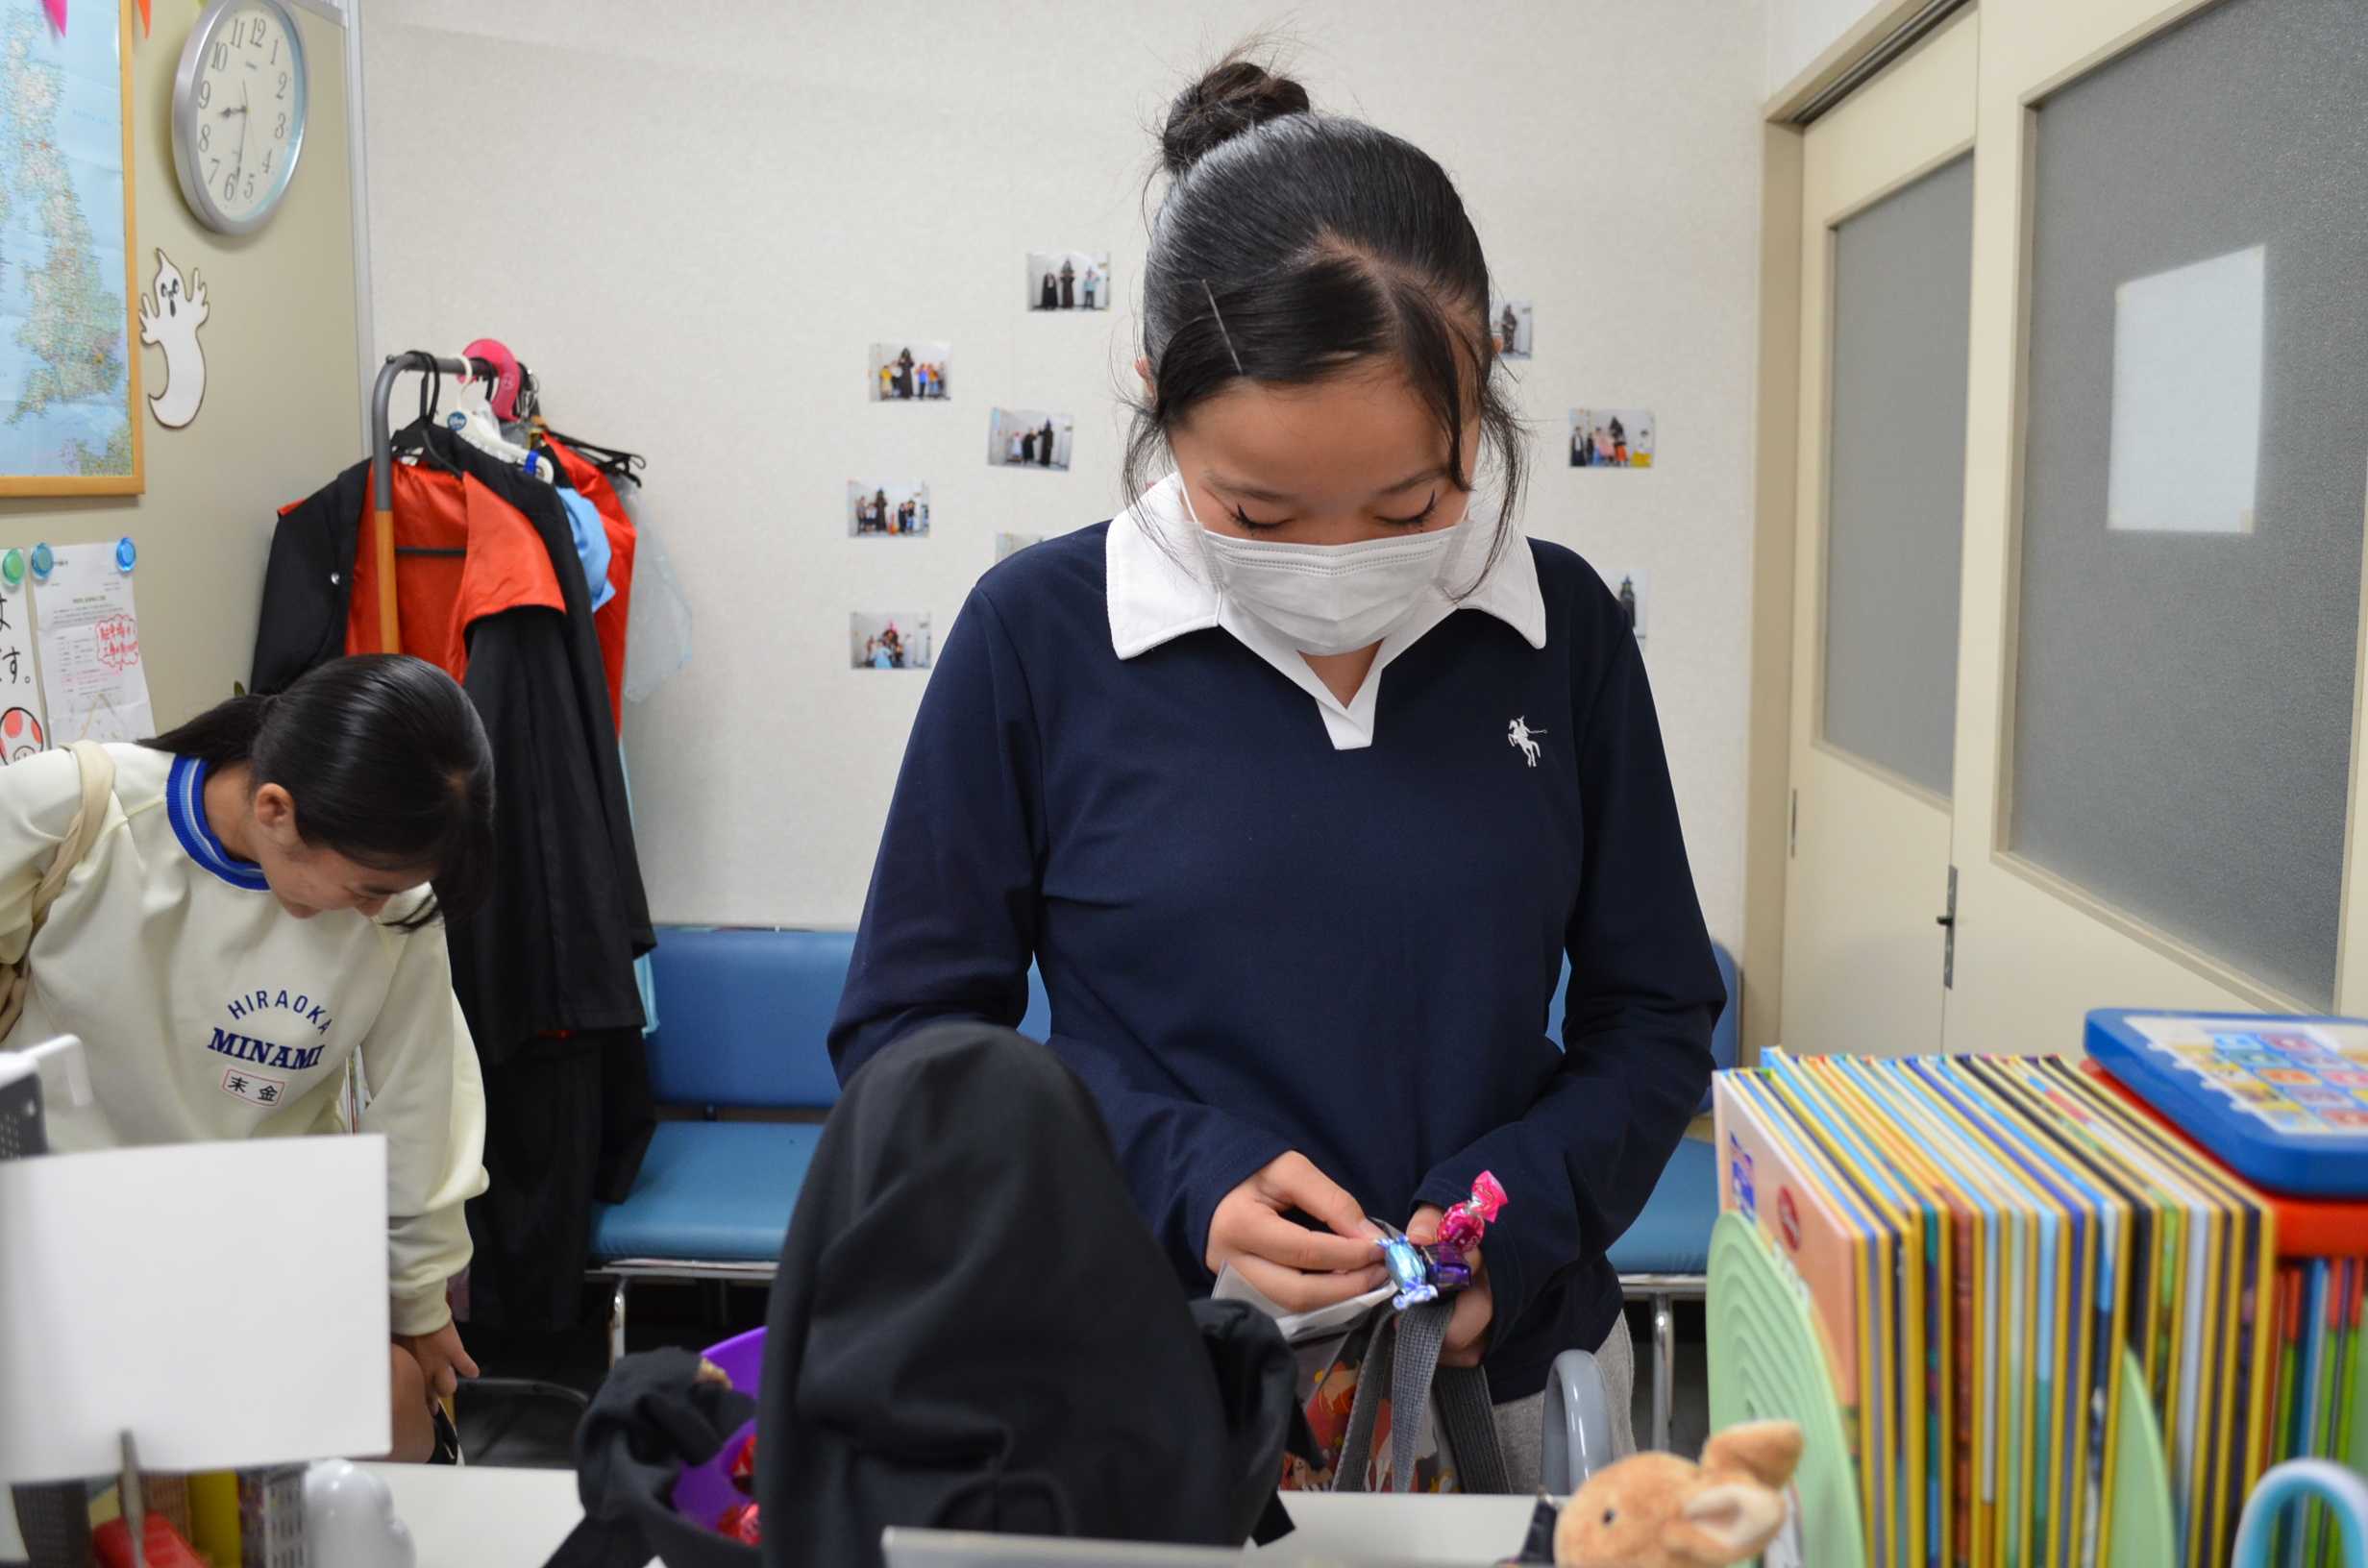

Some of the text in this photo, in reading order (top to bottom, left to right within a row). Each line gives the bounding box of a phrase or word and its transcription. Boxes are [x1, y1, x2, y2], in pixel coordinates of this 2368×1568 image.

[230, 18, 245, 49] 11
[250, 17, 267, 48] 12
[211, 41, 228, 72] 10
[270, 38, 279, 64] 1
[198, 81, 210, 110] 9
[276, 71, 287, 99] 2
[198, 123, 210, 152] 8
[275, 111, 286, 139] 3
[209, 158, 220, 185] 7
[262, 148, 273, 174] 4
[224, 171, 234, 201] 6
[244, 173, 255, 199] 5
[0, 646, 31, 685] す。
[227, 990, 333, 1036] HIRAOKA
[207, 1026, 326, 1070] MINAMI
